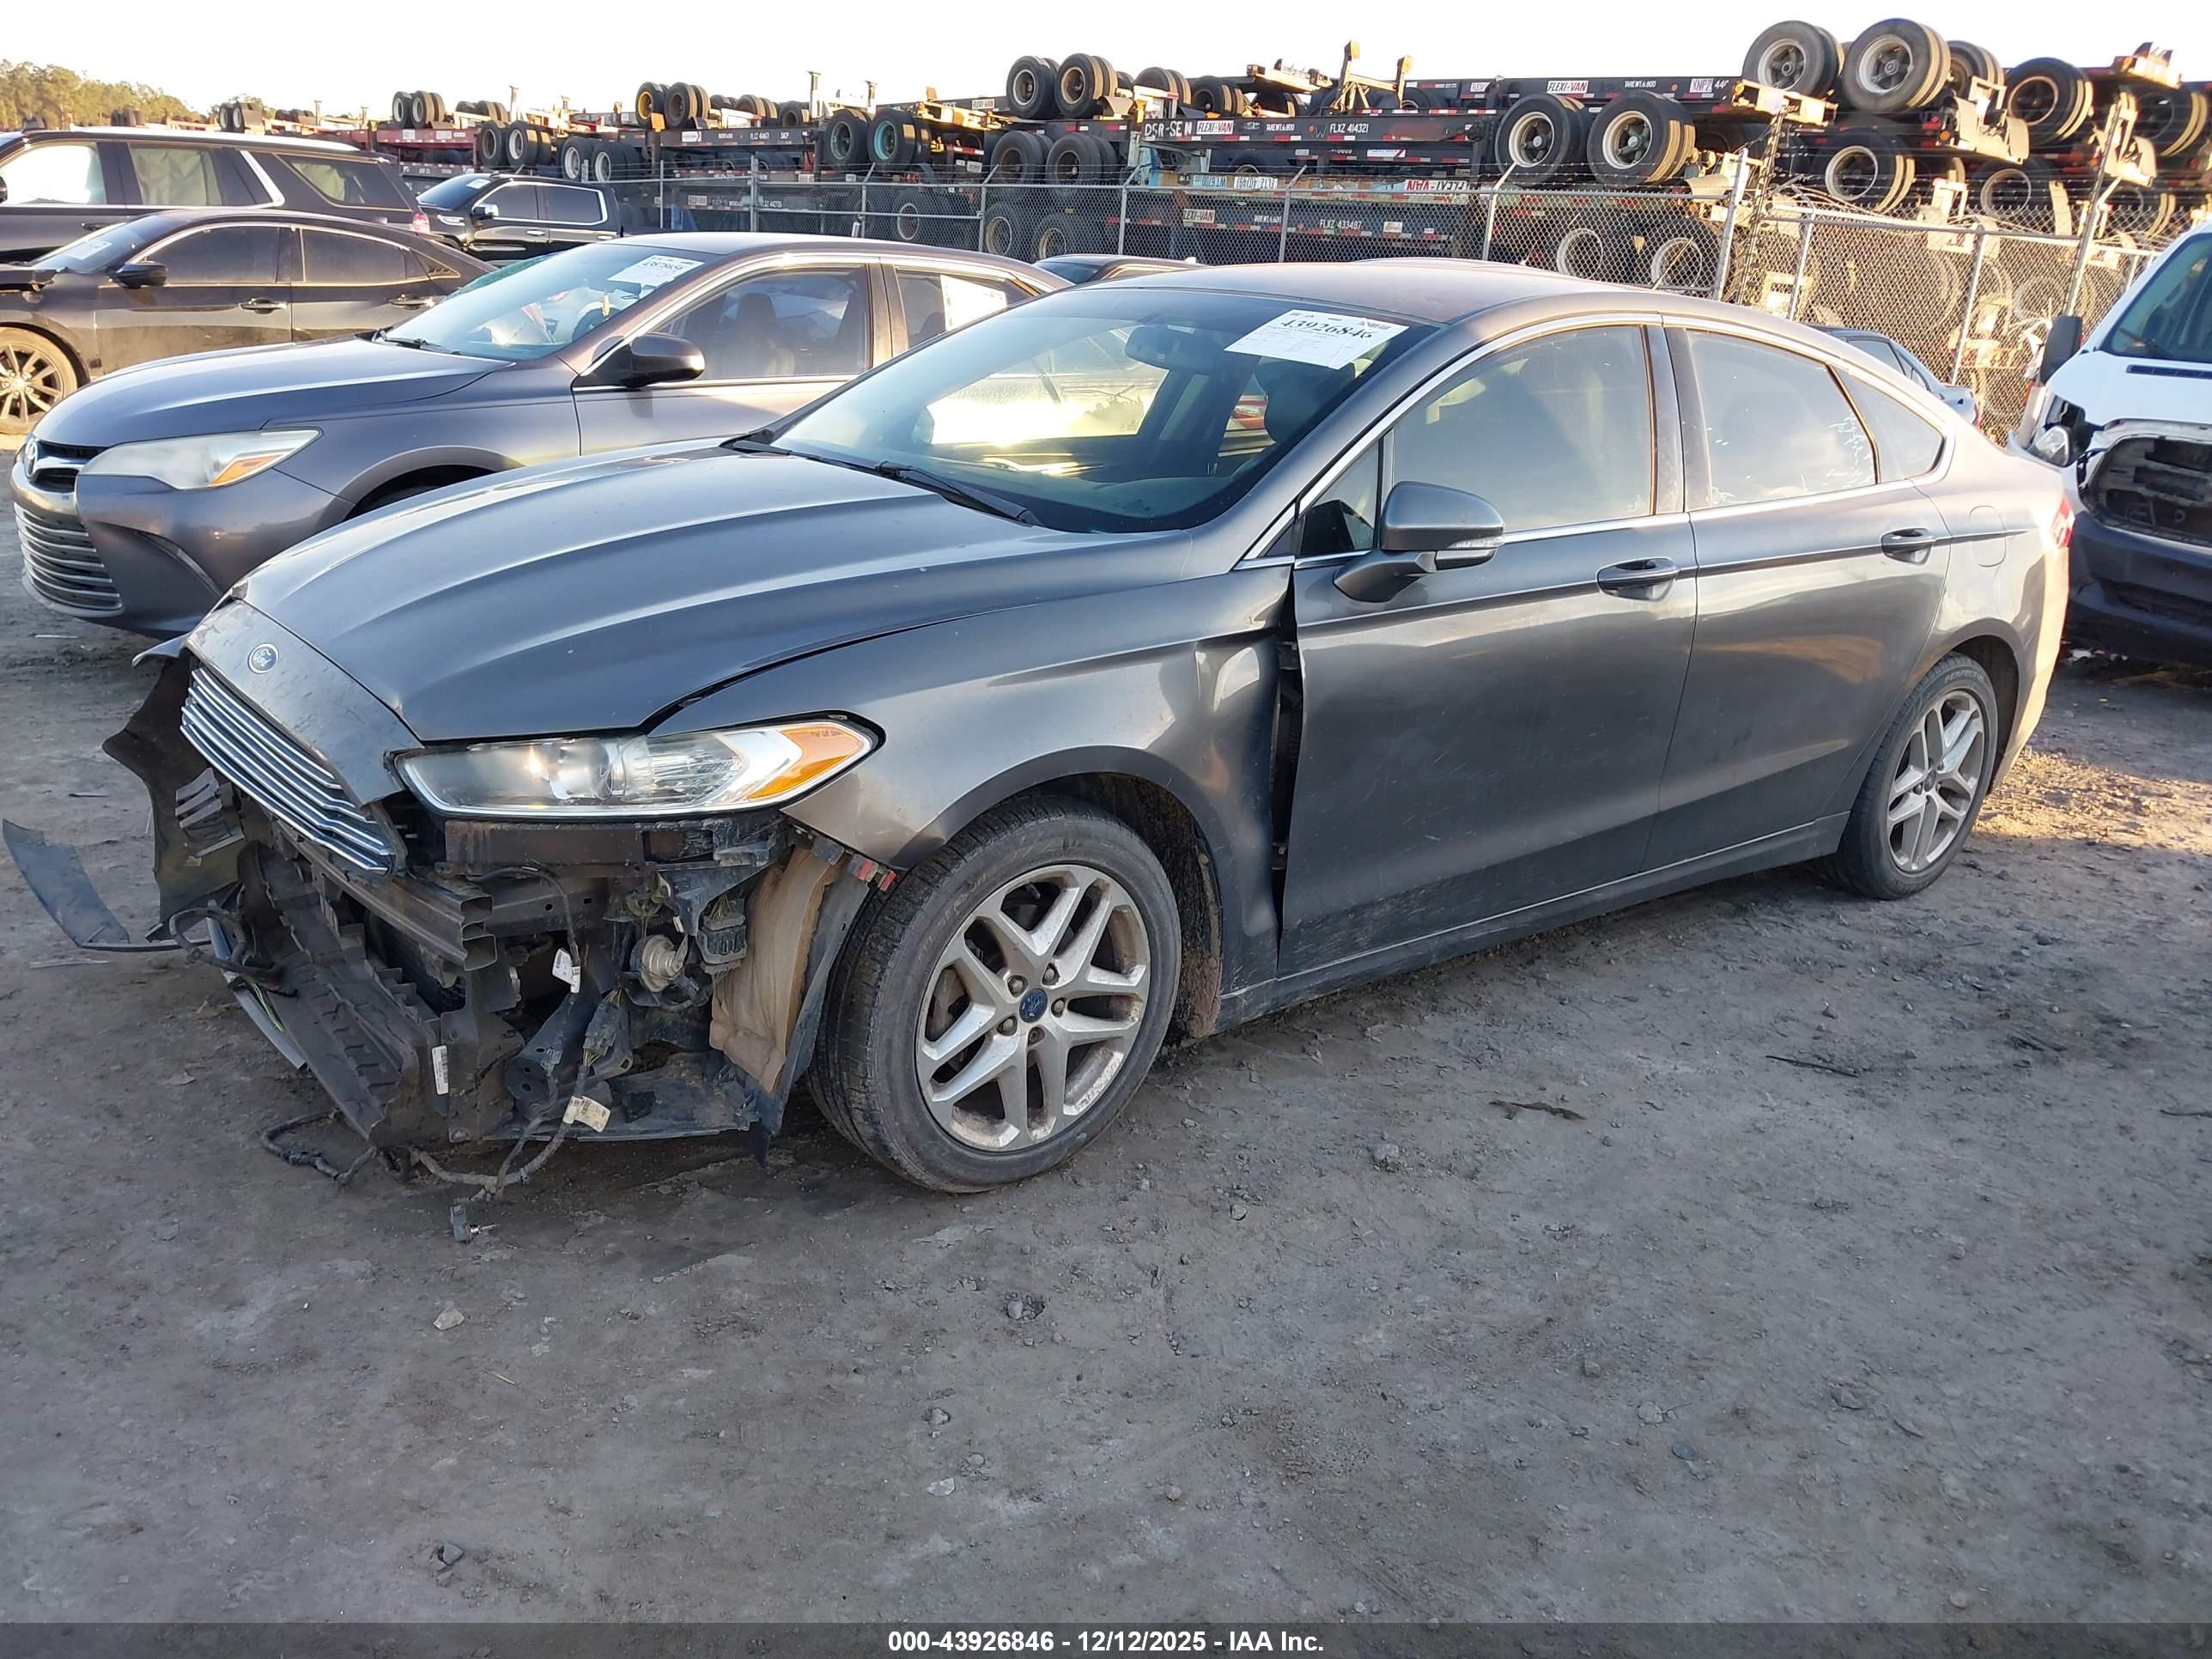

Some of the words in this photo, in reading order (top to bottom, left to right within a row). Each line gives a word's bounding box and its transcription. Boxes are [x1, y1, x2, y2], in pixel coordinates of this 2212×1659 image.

[1547, 81, 1587, 92] FLEXI-VAN
[1197, 121, 1233, 134] FLEXI-VAN
[1329, 123, 1346, 133] FLXZ
[1346, 123, 1369, 133] 414321
[1183, 210, 1214, 222] LEXI-VAN
[1320, 219, 1335, 229] FLXZ
